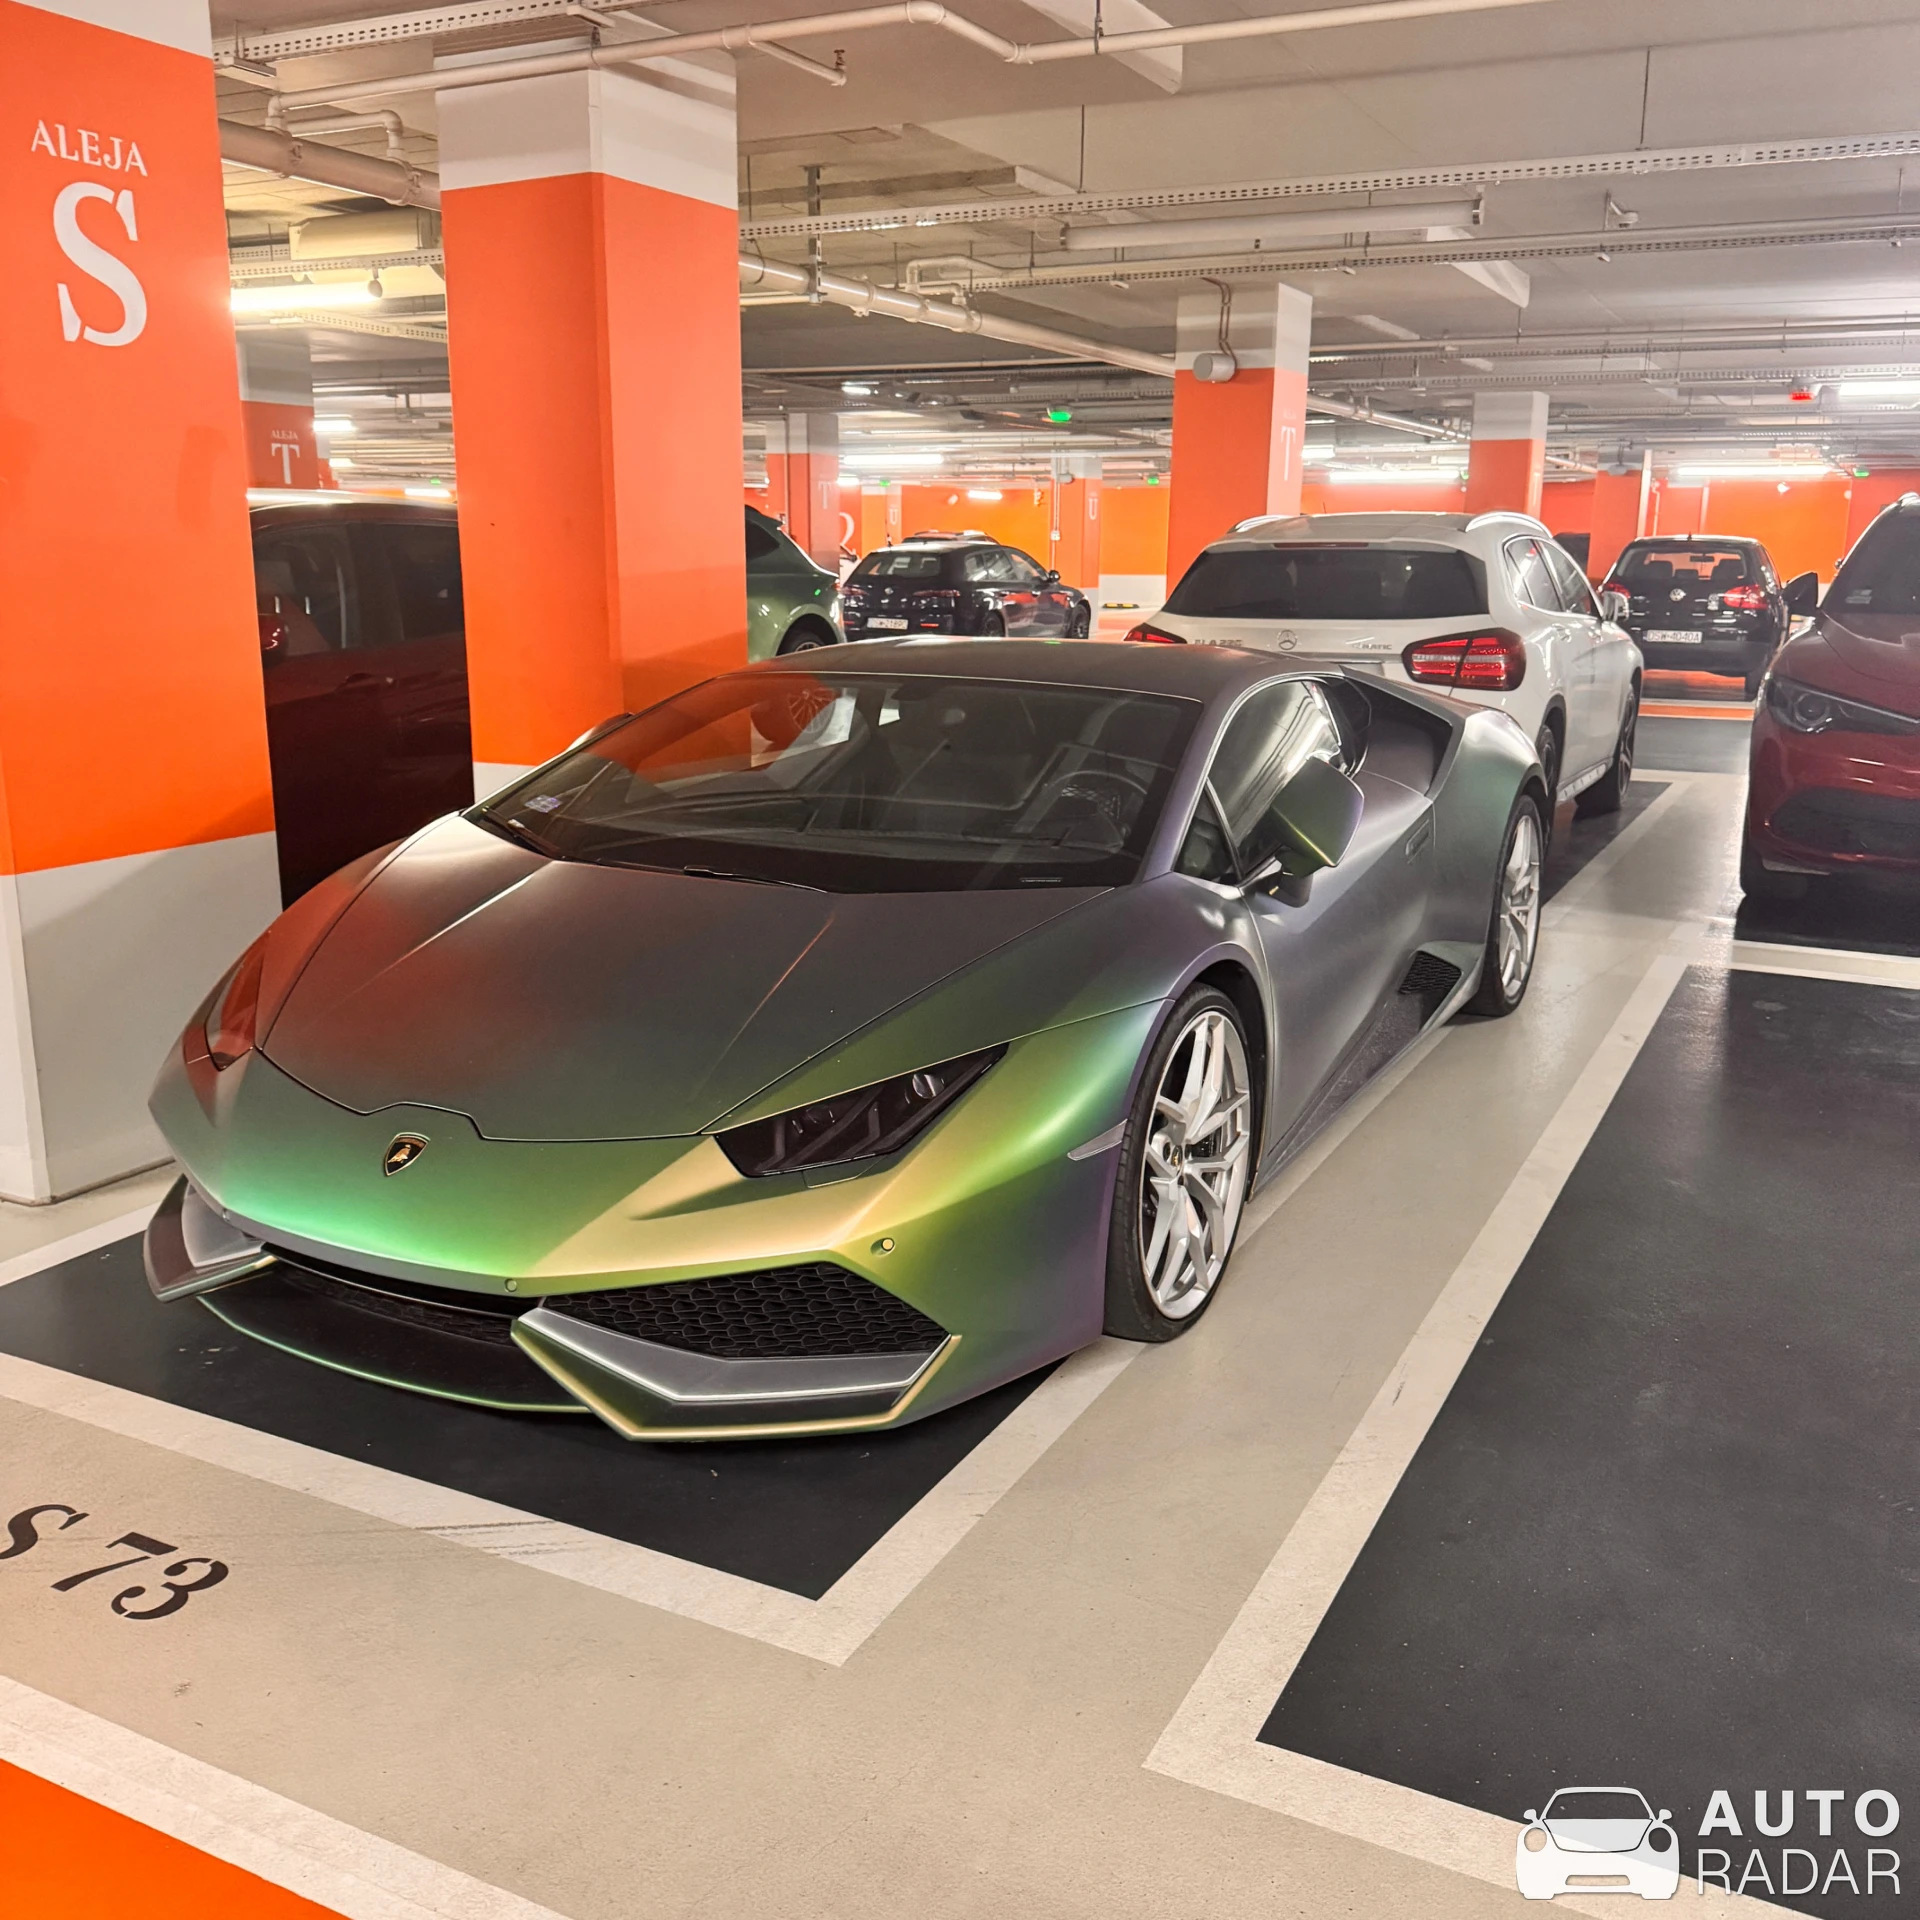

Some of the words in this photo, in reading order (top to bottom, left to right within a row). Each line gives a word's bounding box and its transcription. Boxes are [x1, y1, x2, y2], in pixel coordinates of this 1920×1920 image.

[31, 119, 149, 177] ALEJA
[52, 181, 148, 347] S
[271, 443, 300, 485] T
[1281, 425, 1296, 481] T
[0, 1504, 90, 1560] S
[50, 1531, 229, 1620] 73
